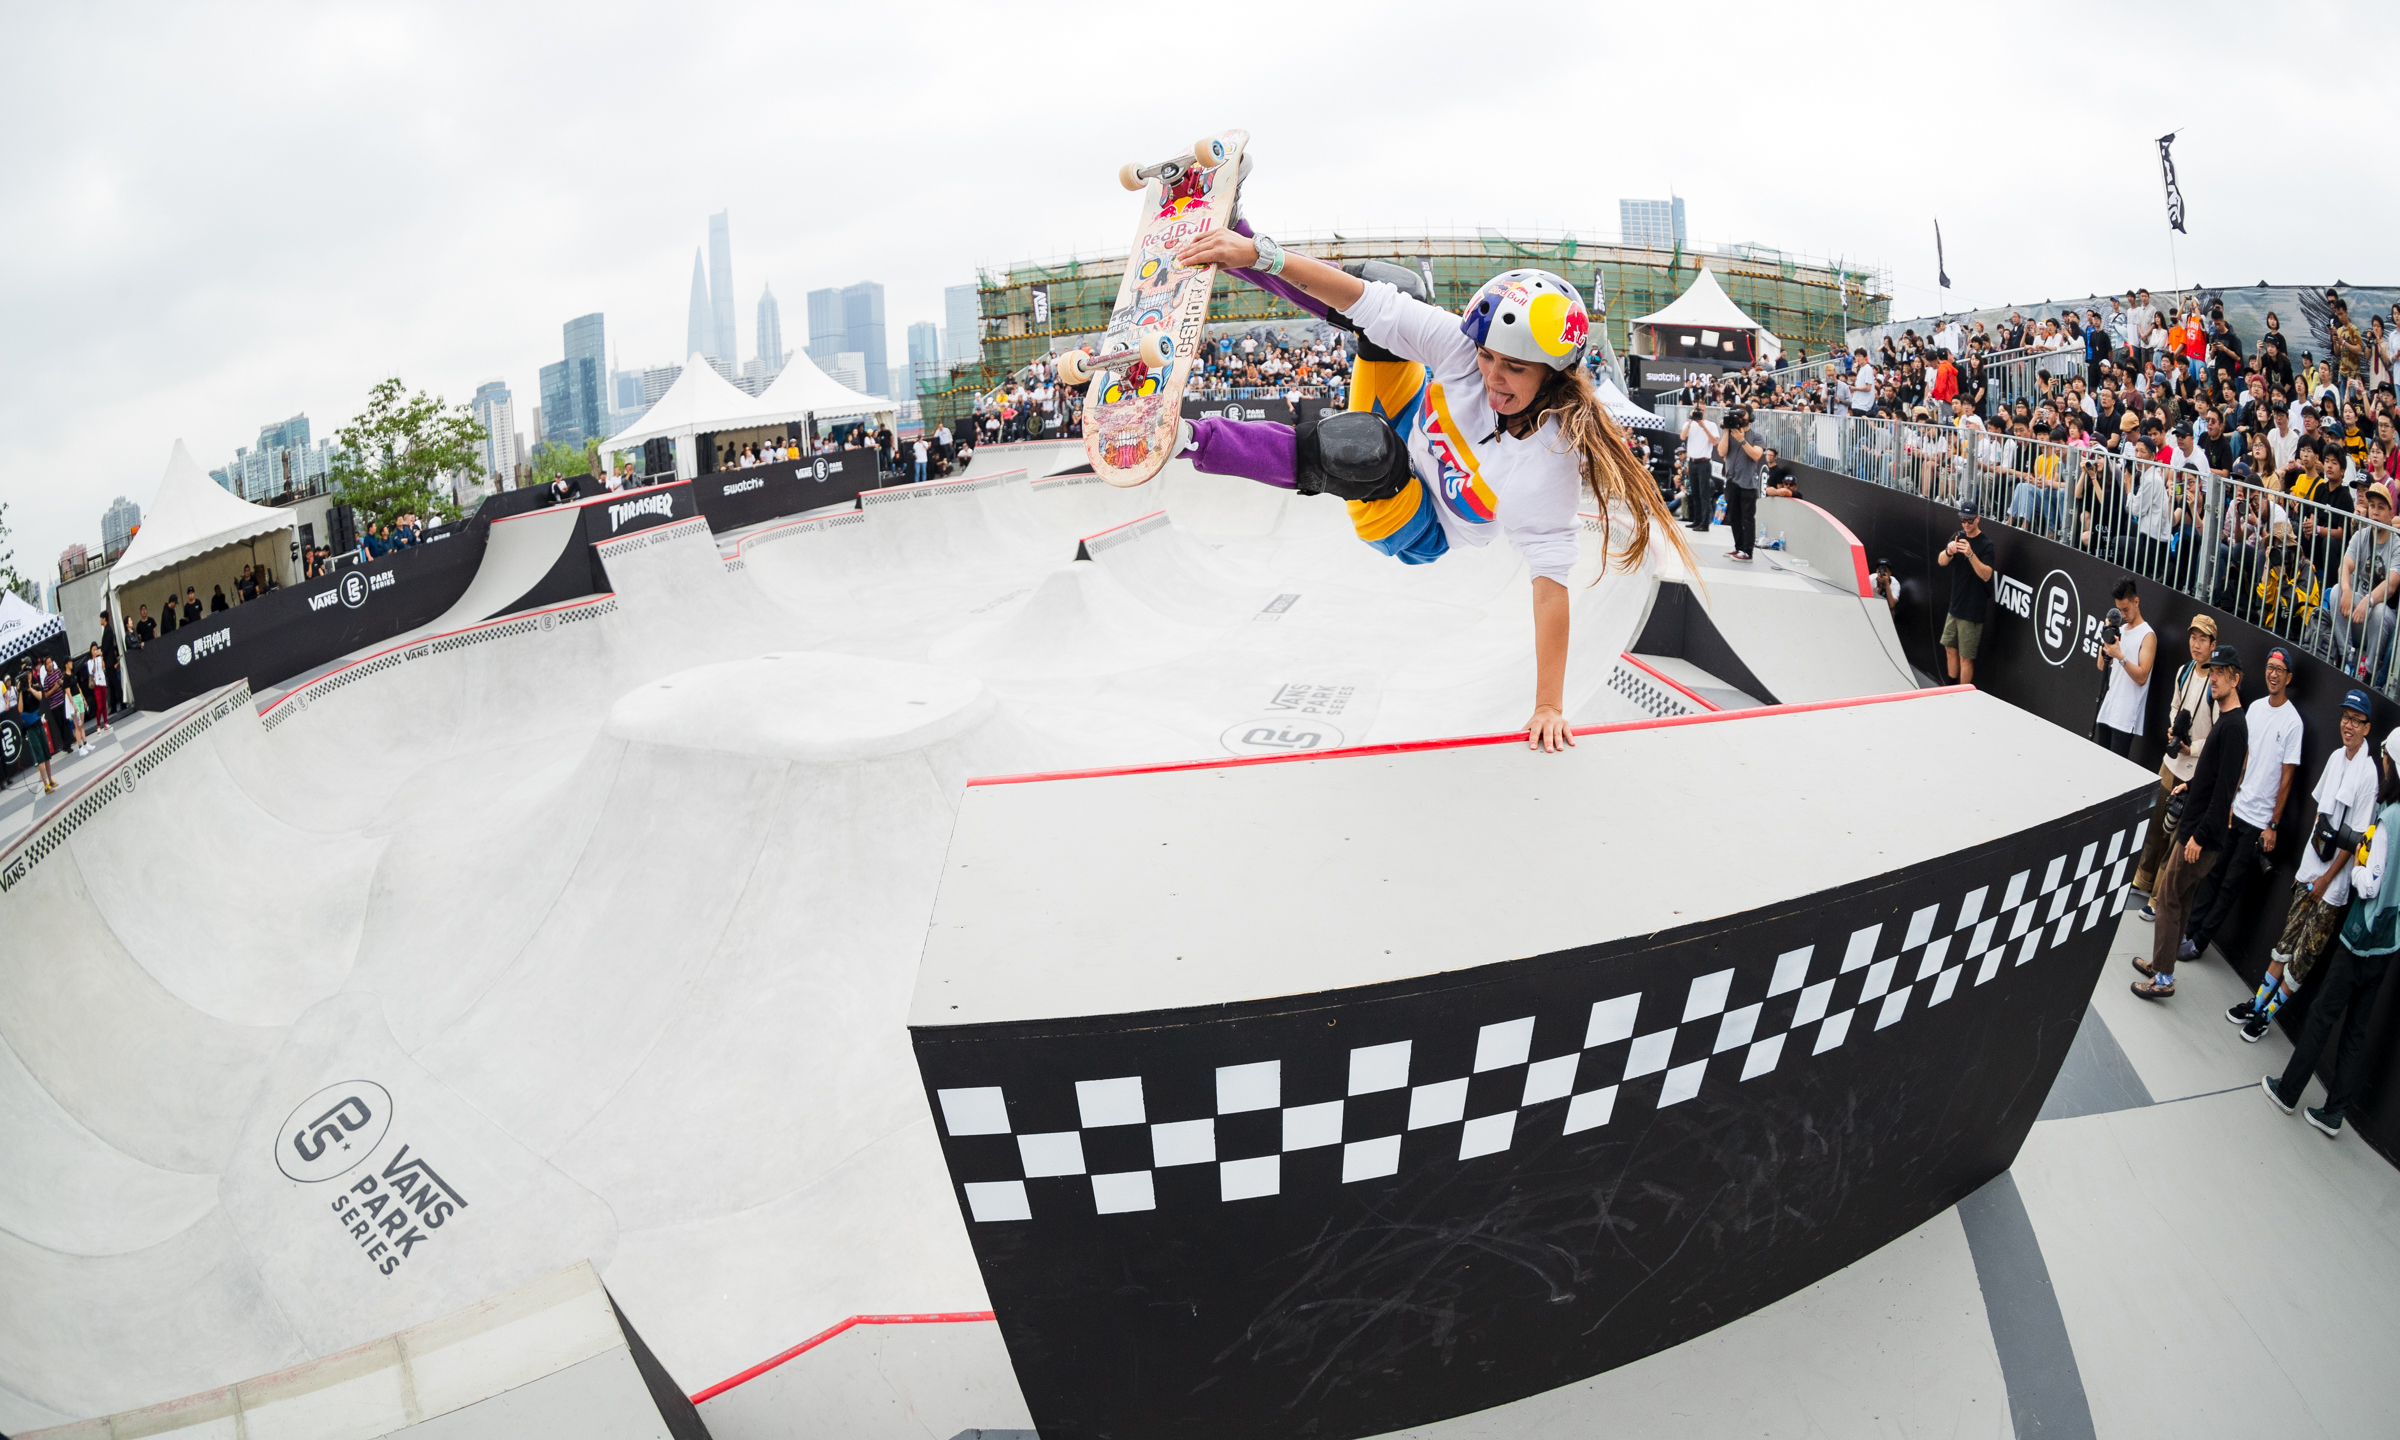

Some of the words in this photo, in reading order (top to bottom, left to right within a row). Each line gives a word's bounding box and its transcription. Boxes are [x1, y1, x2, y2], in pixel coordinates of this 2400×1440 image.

[1141, 226, 1174, 249] Red
[1175, 218, 1212, 238] Bull
[1488, 285, 1507, 297] Red
[1507, 291, 1528, 306] Bull
[795, 467, 812, 480] VANS
[912, 488, 932, 498] VANS
[608, 492, 673, 533] THRASHER
[647, 531, 670, 545] VANS
[308, 588, 339, 612] VANS
[370, 569, 394, 585] PARK
[371, 578, 396, 591] SERIES
[1994, 570, 2033, 618] VANS
[2085, 614, 2104, 640] PA
[404, 645, 430, 662] VANS
[211, 701, 230, 722] VANS
[1264, 683, 1313, 711] VANS
[1301, 684, 1338, 714] PARK
[1327, 685, 1356, 716] SERIES
[0, 856, 27, 893] VANS
[381, 1143, 469, 1229] VANS
[350, 1174, 429, 1259] PARK
[331, 1195, 401, 1276] SERIES
